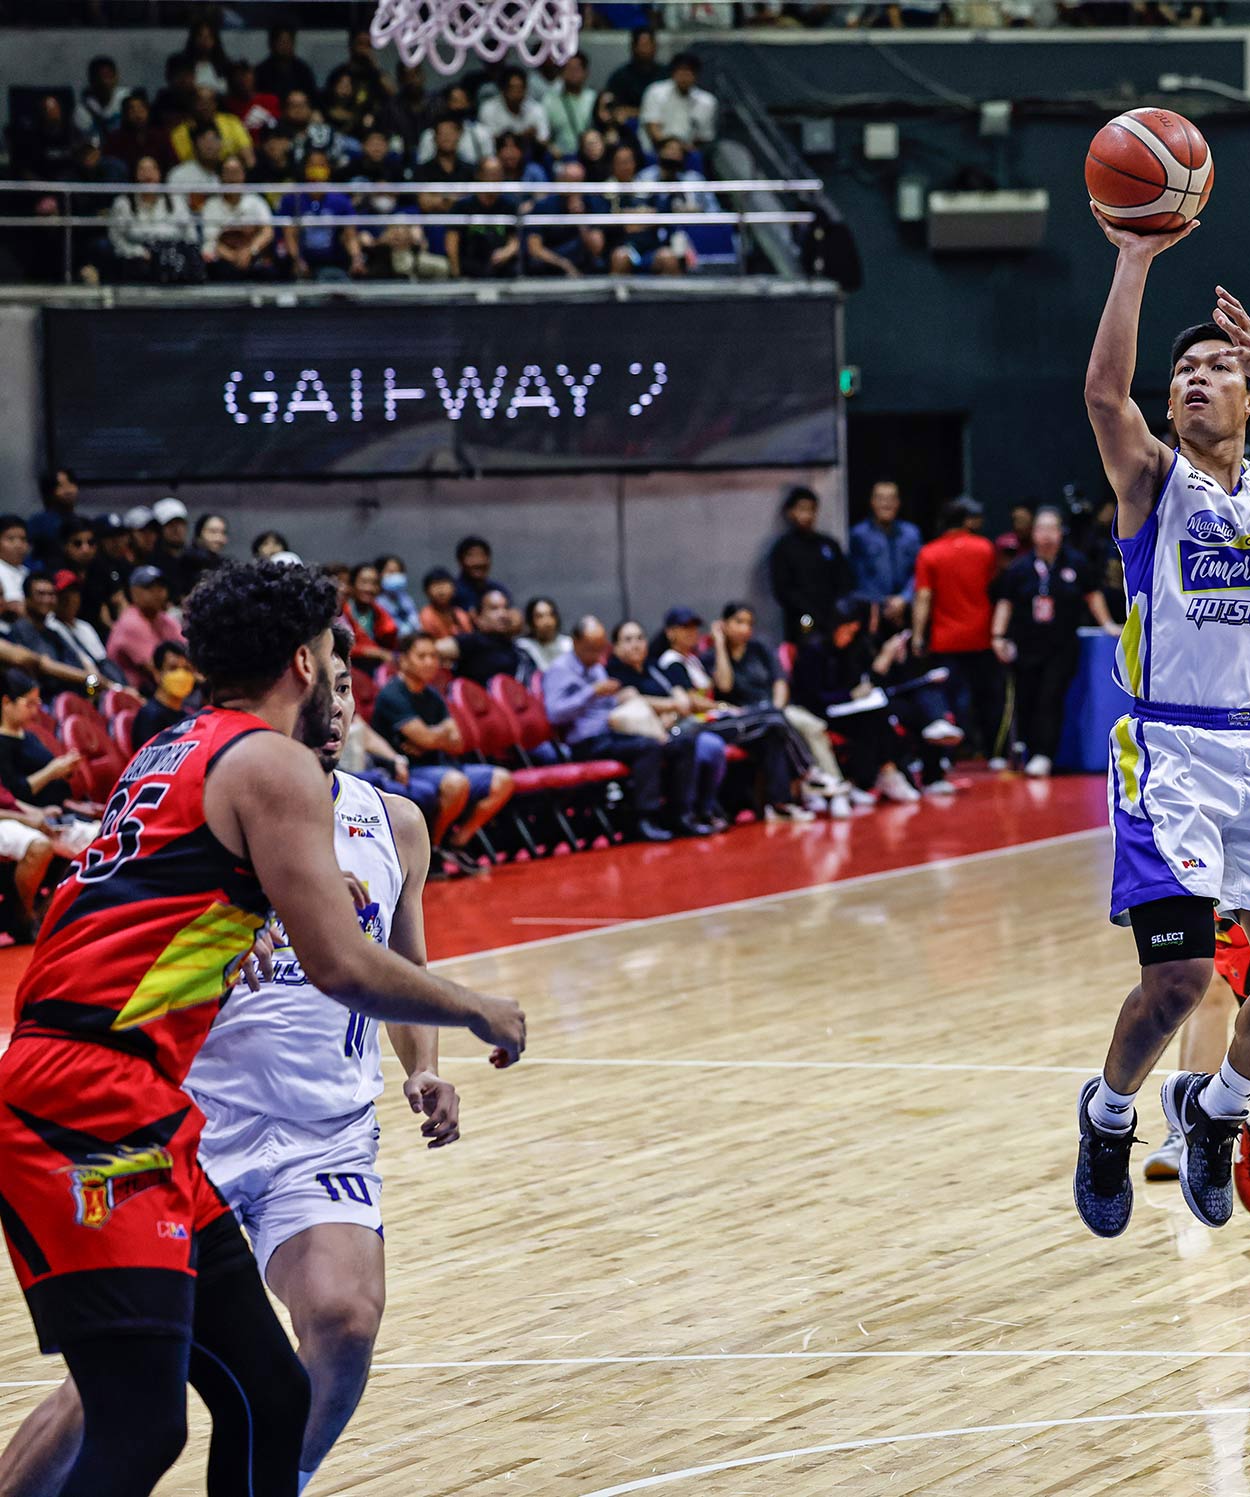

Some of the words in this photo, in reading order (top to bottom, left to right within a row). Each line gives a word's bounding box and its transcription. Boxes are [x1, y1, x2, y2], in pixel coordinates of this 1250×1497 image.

[1186, 516, 1235, 543] Magnolia
[341, 812, 380, 824] FINALS
[1151, 931, 1184, 945] SELECT
[315, 1172, 373, 1207] 10
